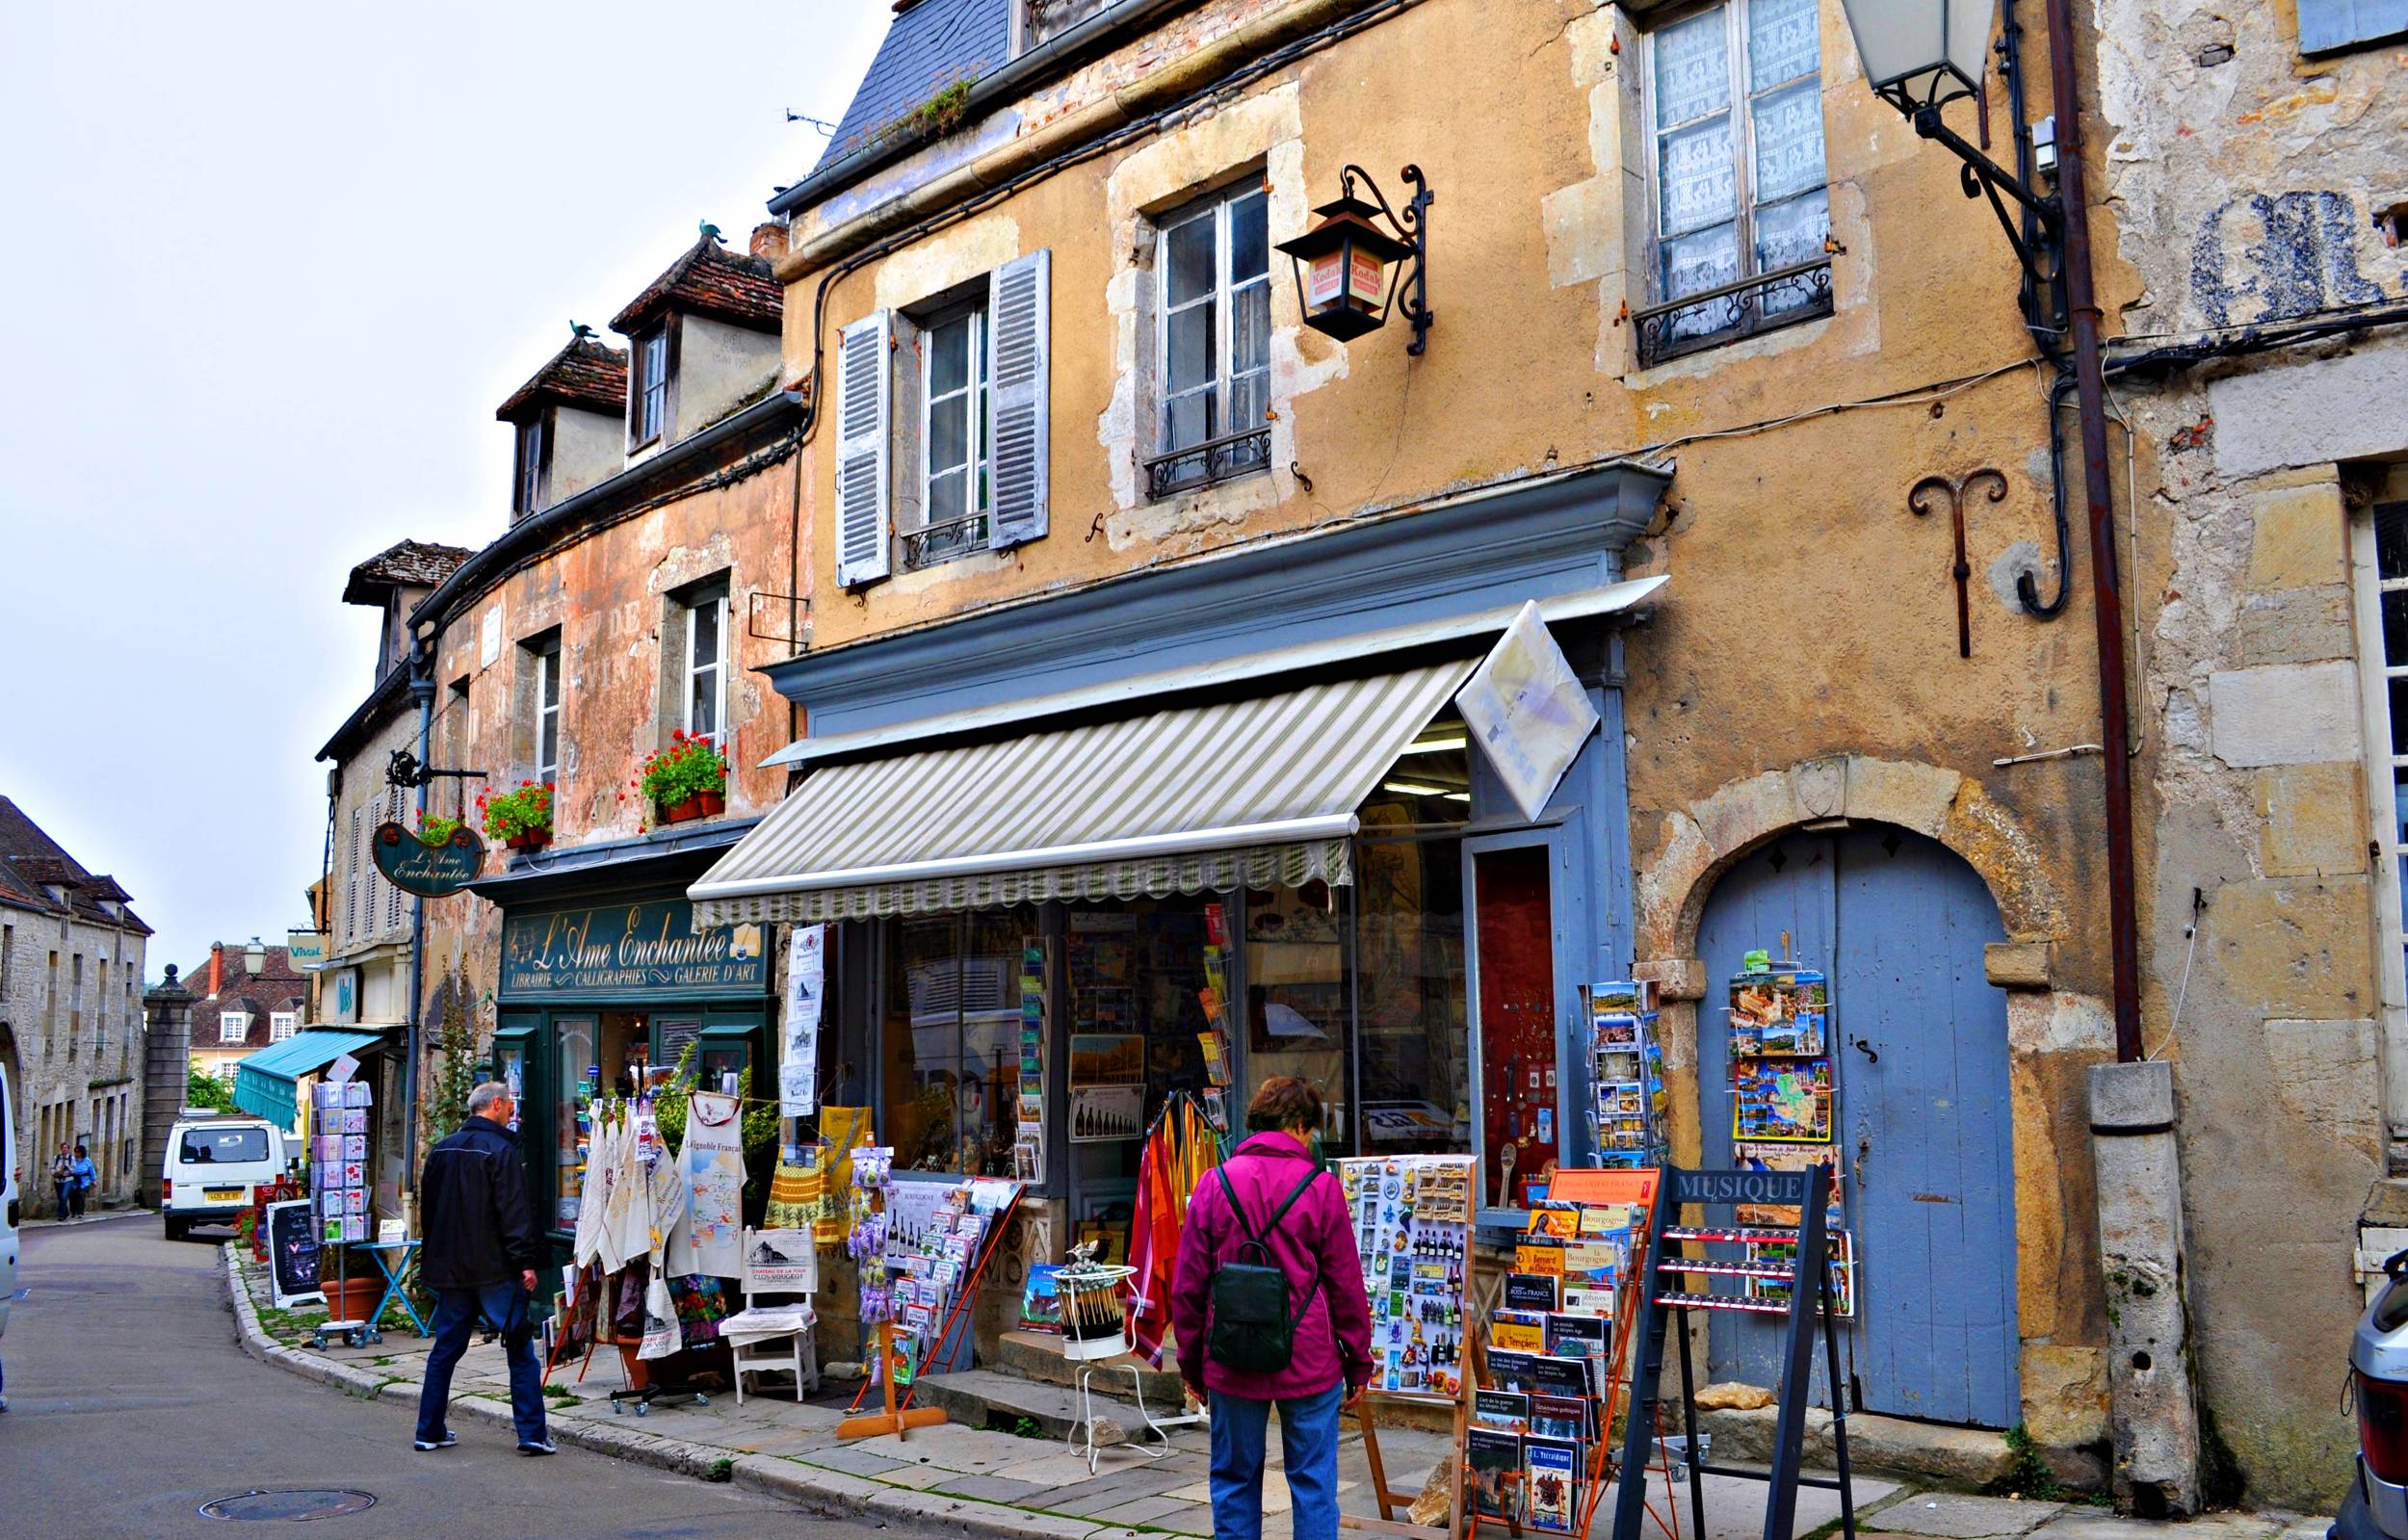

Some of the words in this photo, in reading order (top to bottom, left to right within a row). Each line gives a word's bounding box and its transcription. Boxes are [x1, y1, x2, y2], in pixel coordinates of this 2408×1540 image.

[1351, 264, 1380, 288] Kodak
[618, 905, 726, 966] Enchantée
[291, 947, 323, 957] Vival
[511, 973, 553, 988] LIBRAIRIE
[575, 968, 647, 987] CALLIGRAPHIES
[674, 965, 719, 983] GALERIE
[723, 963, 758, 981] D'ART
[1678, 1176, 1801, 1202] MUSIQUE
[1583, 1214, 1627, 1224] Bourgogne
[1567, 1253, 1609, 1265] Bourgogne
[1509, 1336, 1539, 1349] Templiers
